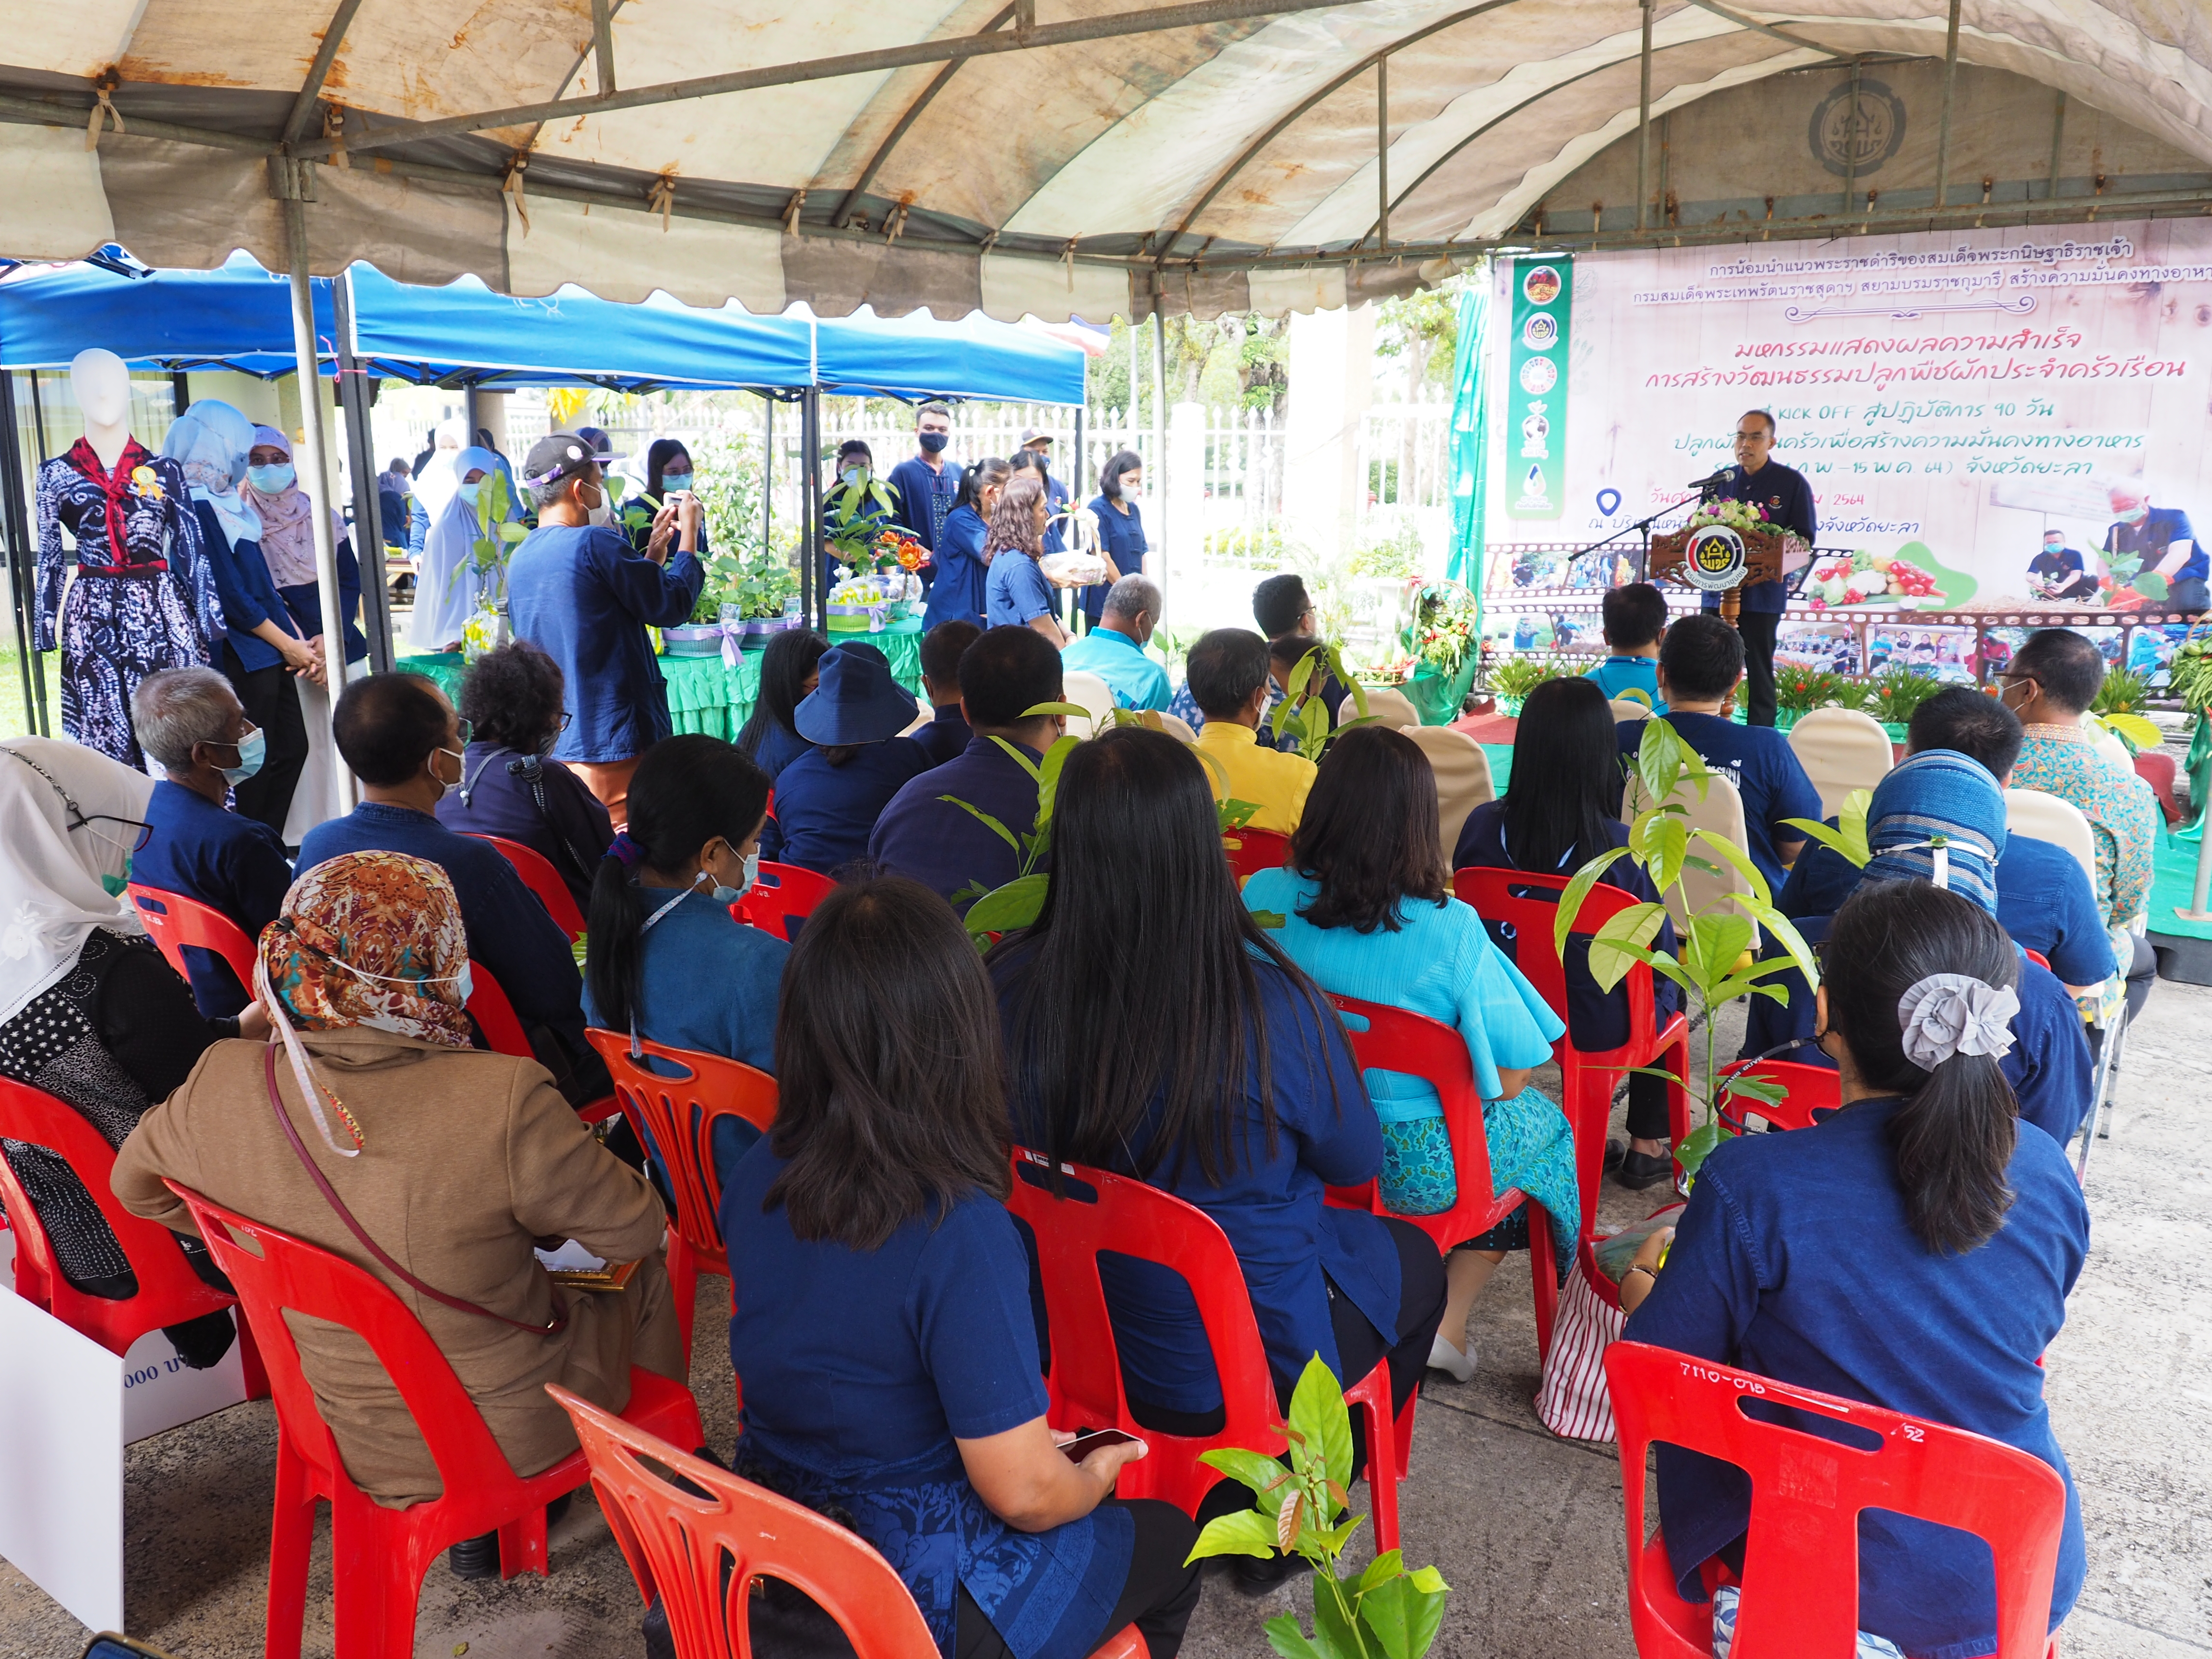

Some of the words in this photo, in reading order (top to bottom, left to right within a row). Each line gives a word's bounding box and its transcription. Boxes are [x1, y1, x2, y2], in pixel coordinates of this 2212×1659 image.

[1862, 270, 2001, 292] สยามบรมราชกุมารี
[1734, 326, 2082, 358] มหกรรมแสดงผลความสำเร็จ
[1645, 354, 2187, 391] การสร้างวัฒนธรรมปลูกพืชผักประจำครัวเรือน
[1778, 407, 1812, 420] KICK
[1819, 405, 1857, 420] OFF
[1863, 399, 1986, 426] สู่ปฏิบัติการ
[1995, 402, 2016, 417] 90
[2026, 397, 2054, 416] วัน
[1966, 456, 2092, 475] จังหวัดยะลา
[1833, 493, 1864, 505] 2564
[1685, 568, 1746, 589] กรมการพัฒนาชุมชน
